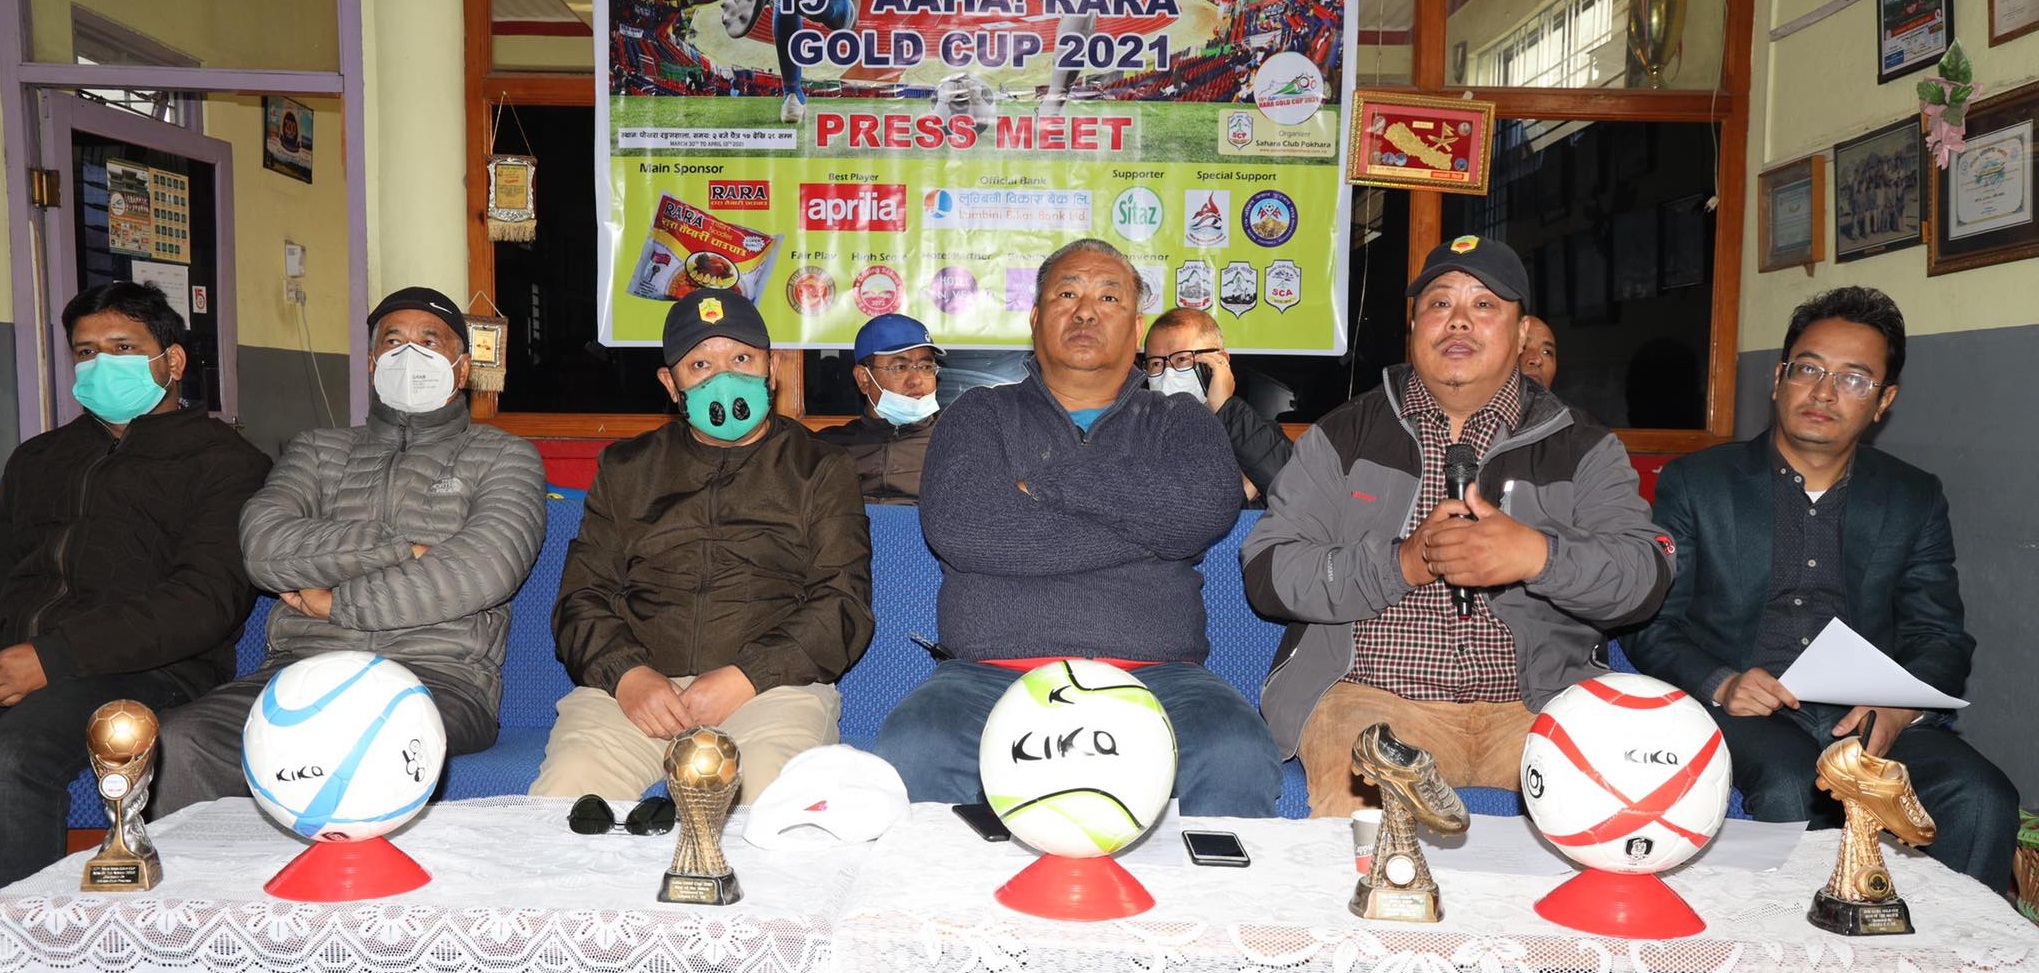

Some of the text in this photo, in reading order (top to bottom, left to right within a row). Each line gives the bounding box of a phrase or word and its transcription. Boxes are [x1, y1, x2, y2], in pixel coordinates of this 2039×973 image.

[788, 29, 1170, 71] GOLD CUP 2021
[815, 113, 1134, 151] PRESS MEET
[639, 163, 724, 175] Main Sponsor
[1112, 169, 1165, 180] Supporter
[828, 172, 879, 183] Best Player
[1019, 176, 1047, 185] Bank
[1196, 171, 1277, 182] Special Support
[710, 185, 768, 199] RARA
[808, 191, 897, 224] aprilia
[1118, 194, 1157, 225] Sitaz
[663, 200, 705, 229] RARA
[958, 208, 1002, 220] Lumbini
[791, 250, 812, 260] Fair
[851, 252, 877, 263] High
[1271, 288, 1293, 297] SCA
